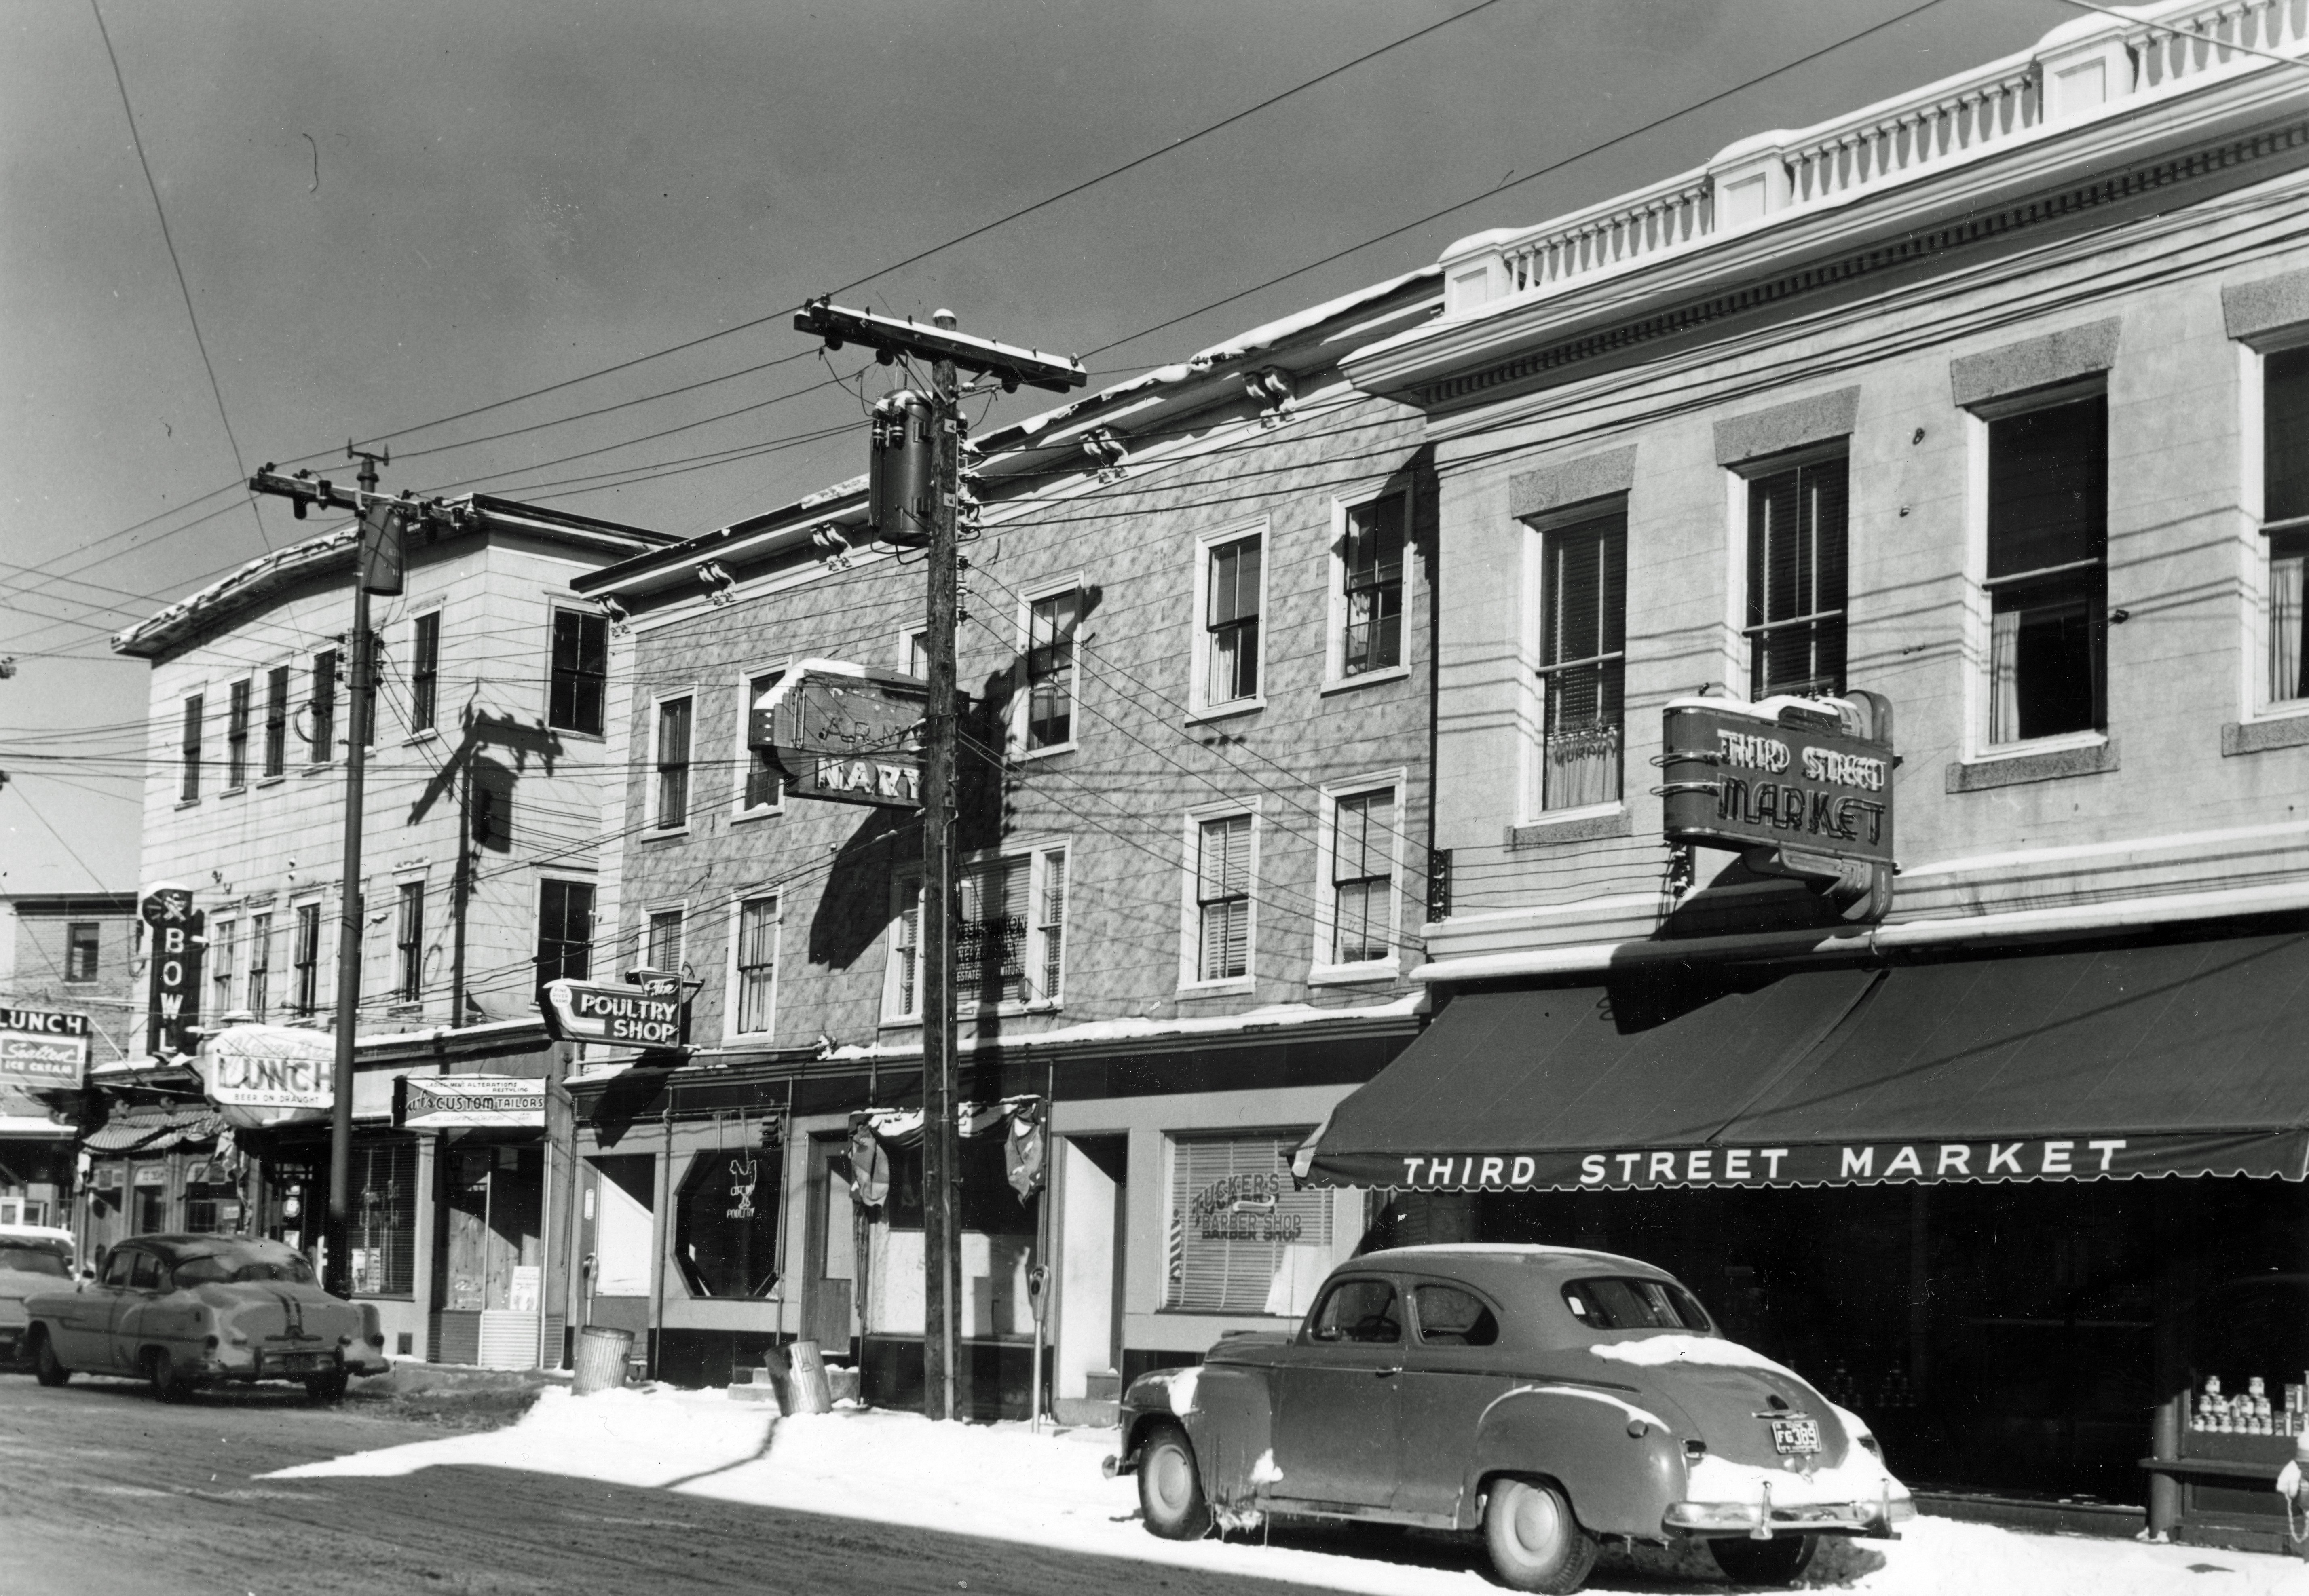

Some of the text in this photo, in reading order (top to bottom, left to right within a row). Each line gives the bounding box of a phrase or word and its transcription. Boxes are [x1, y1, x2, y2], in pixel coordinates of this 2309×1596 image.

[1717, 729, 1887, 792] THIRD STREET
[1717, 773, 1886, 845] MARKET
[160, 928, 185, 1053] BOWL
[581, 994, 678, 1022] POULTRY
[613, 1019, 679, 1042] SHOP
[5, 1060, 72, 1074] ICE CREAM
[218, 1057, 335, 1093] LUNCH
[435, 1096, 494, 1110] CUSTOM
[496, 1098, 543, 1108] TAILORS
[1403, 1140, 2127, 1184] THIRD STREET MARKET
[1202, 1214, 1301, 1230] BARBER SHOP
